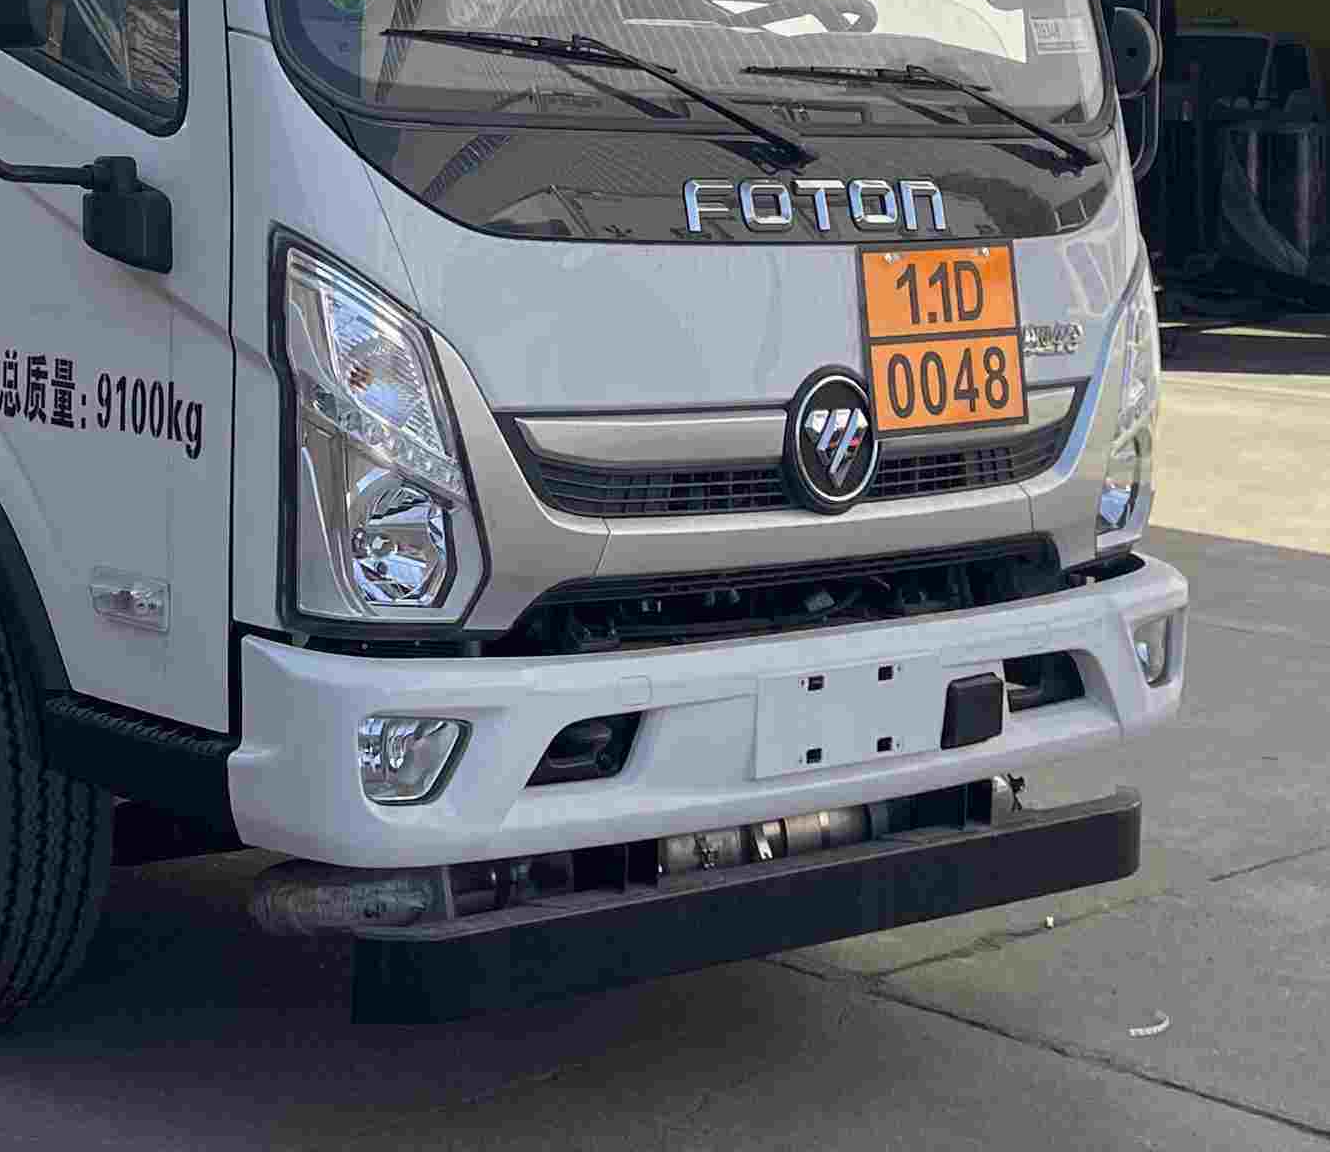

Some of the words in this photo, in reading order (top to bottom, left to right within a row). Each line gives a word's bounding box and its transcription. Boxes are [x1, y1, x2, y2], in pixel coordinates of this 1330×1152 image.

[684, 177, 948, 233] FOTON
[895, 260, 984, 325] 1.1D
[887, 346, 1010, 419] 0048
